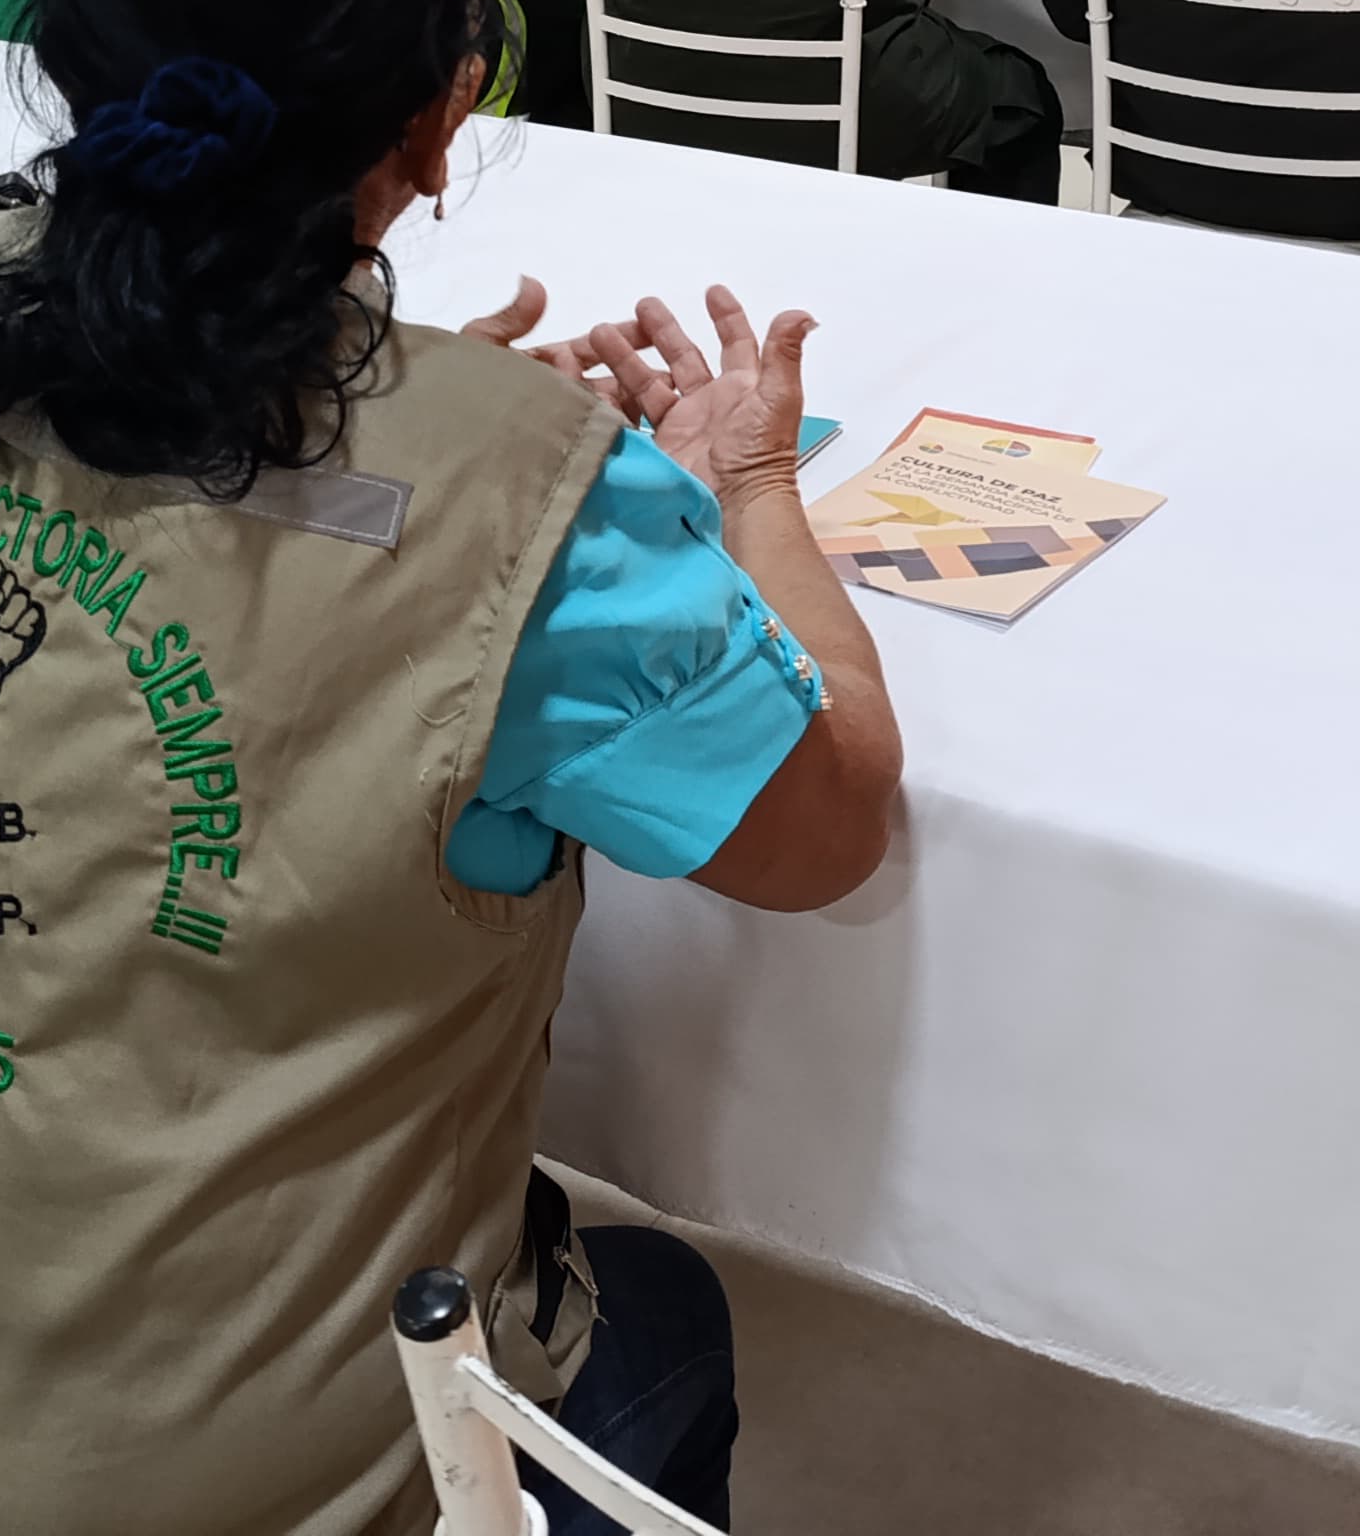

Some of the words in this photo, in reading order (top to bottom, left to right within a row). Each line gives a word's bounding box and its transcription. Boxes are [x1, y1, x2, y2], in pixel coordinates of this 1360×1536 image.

[873, 473, 891, 481] LA
[895, 479, 1016, 515] CONFLICTIVIDAD
[891, 461, 912, 471] EN
[915, 468, 931, 476] LA
[935, 473, 1009, 497] DEMANDA
[1012, 494, 1065, 513] SOCIAL
[895, 471, 911, 479] LA
[1053, 514, 1075, 523] DE
[901, 456, 984, 482] CULTURA
[990, 479, 1019, 490] DE
[1021, 488, 1062, 504] PAZ
